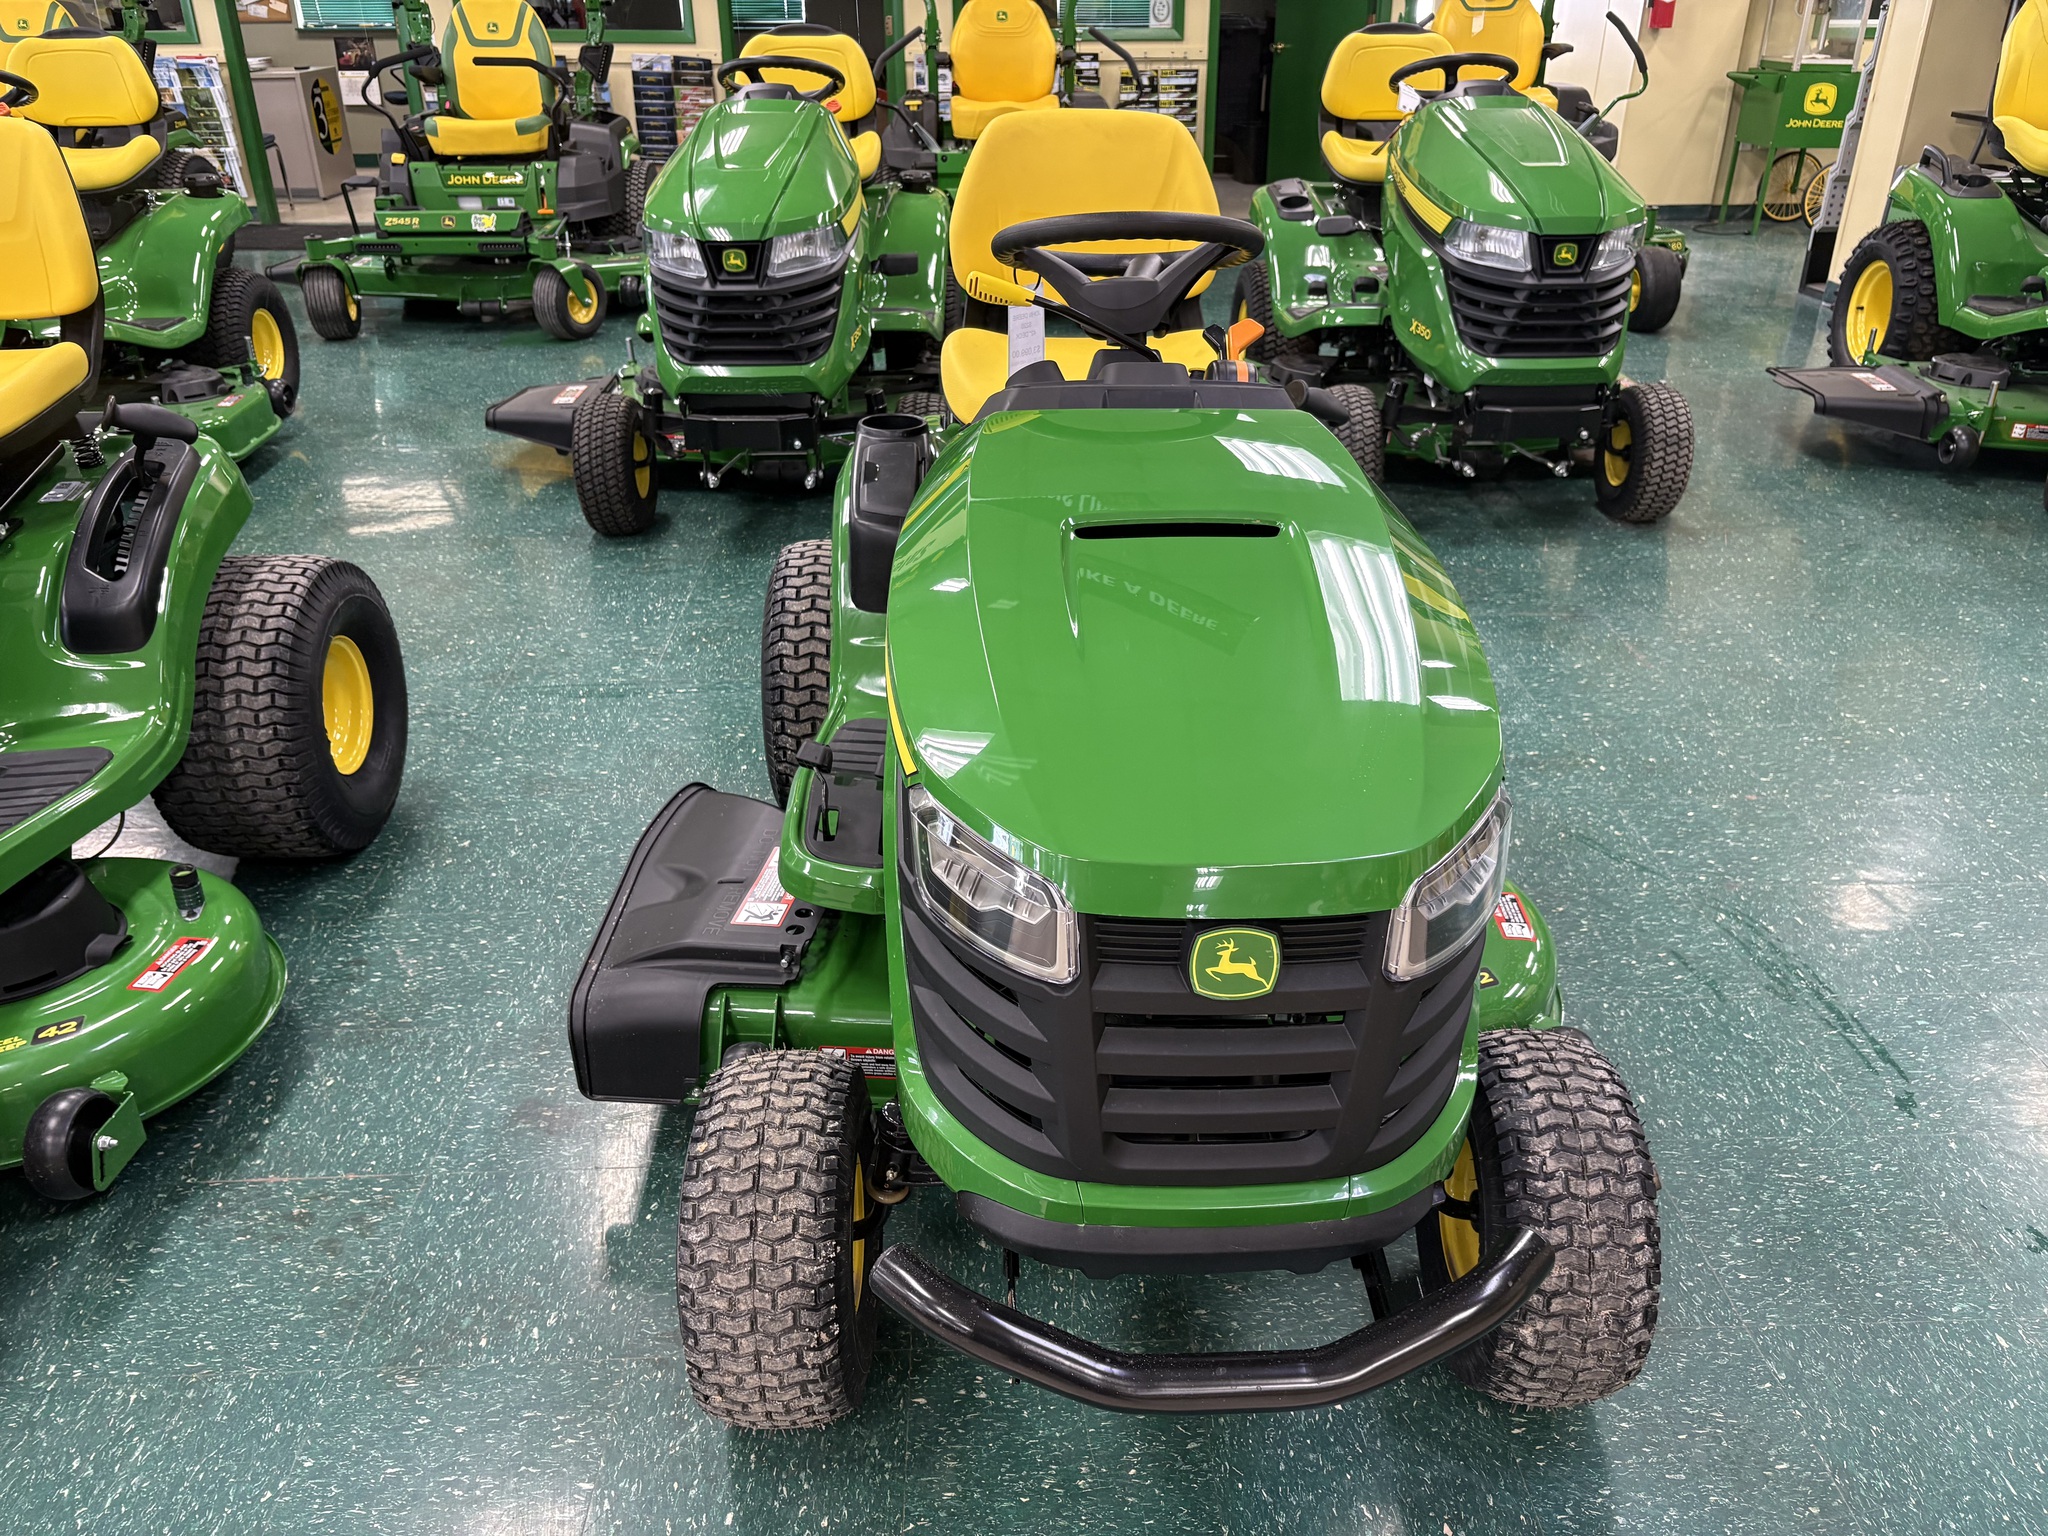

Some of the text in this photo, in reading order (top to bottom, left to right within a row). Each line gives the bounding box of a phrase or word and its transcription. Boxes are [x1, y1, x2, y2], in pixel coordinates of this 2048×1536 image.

[313, 96, 329, 140] 3
[1785, 118, 1844, 129] JOHN DEERE
[447, 174, 480, 185] JOHN
[384, 217, 411, 227] Z545
[1409, 317, 1432, 340] X350
[37, 1021, 78, 1039] 42
